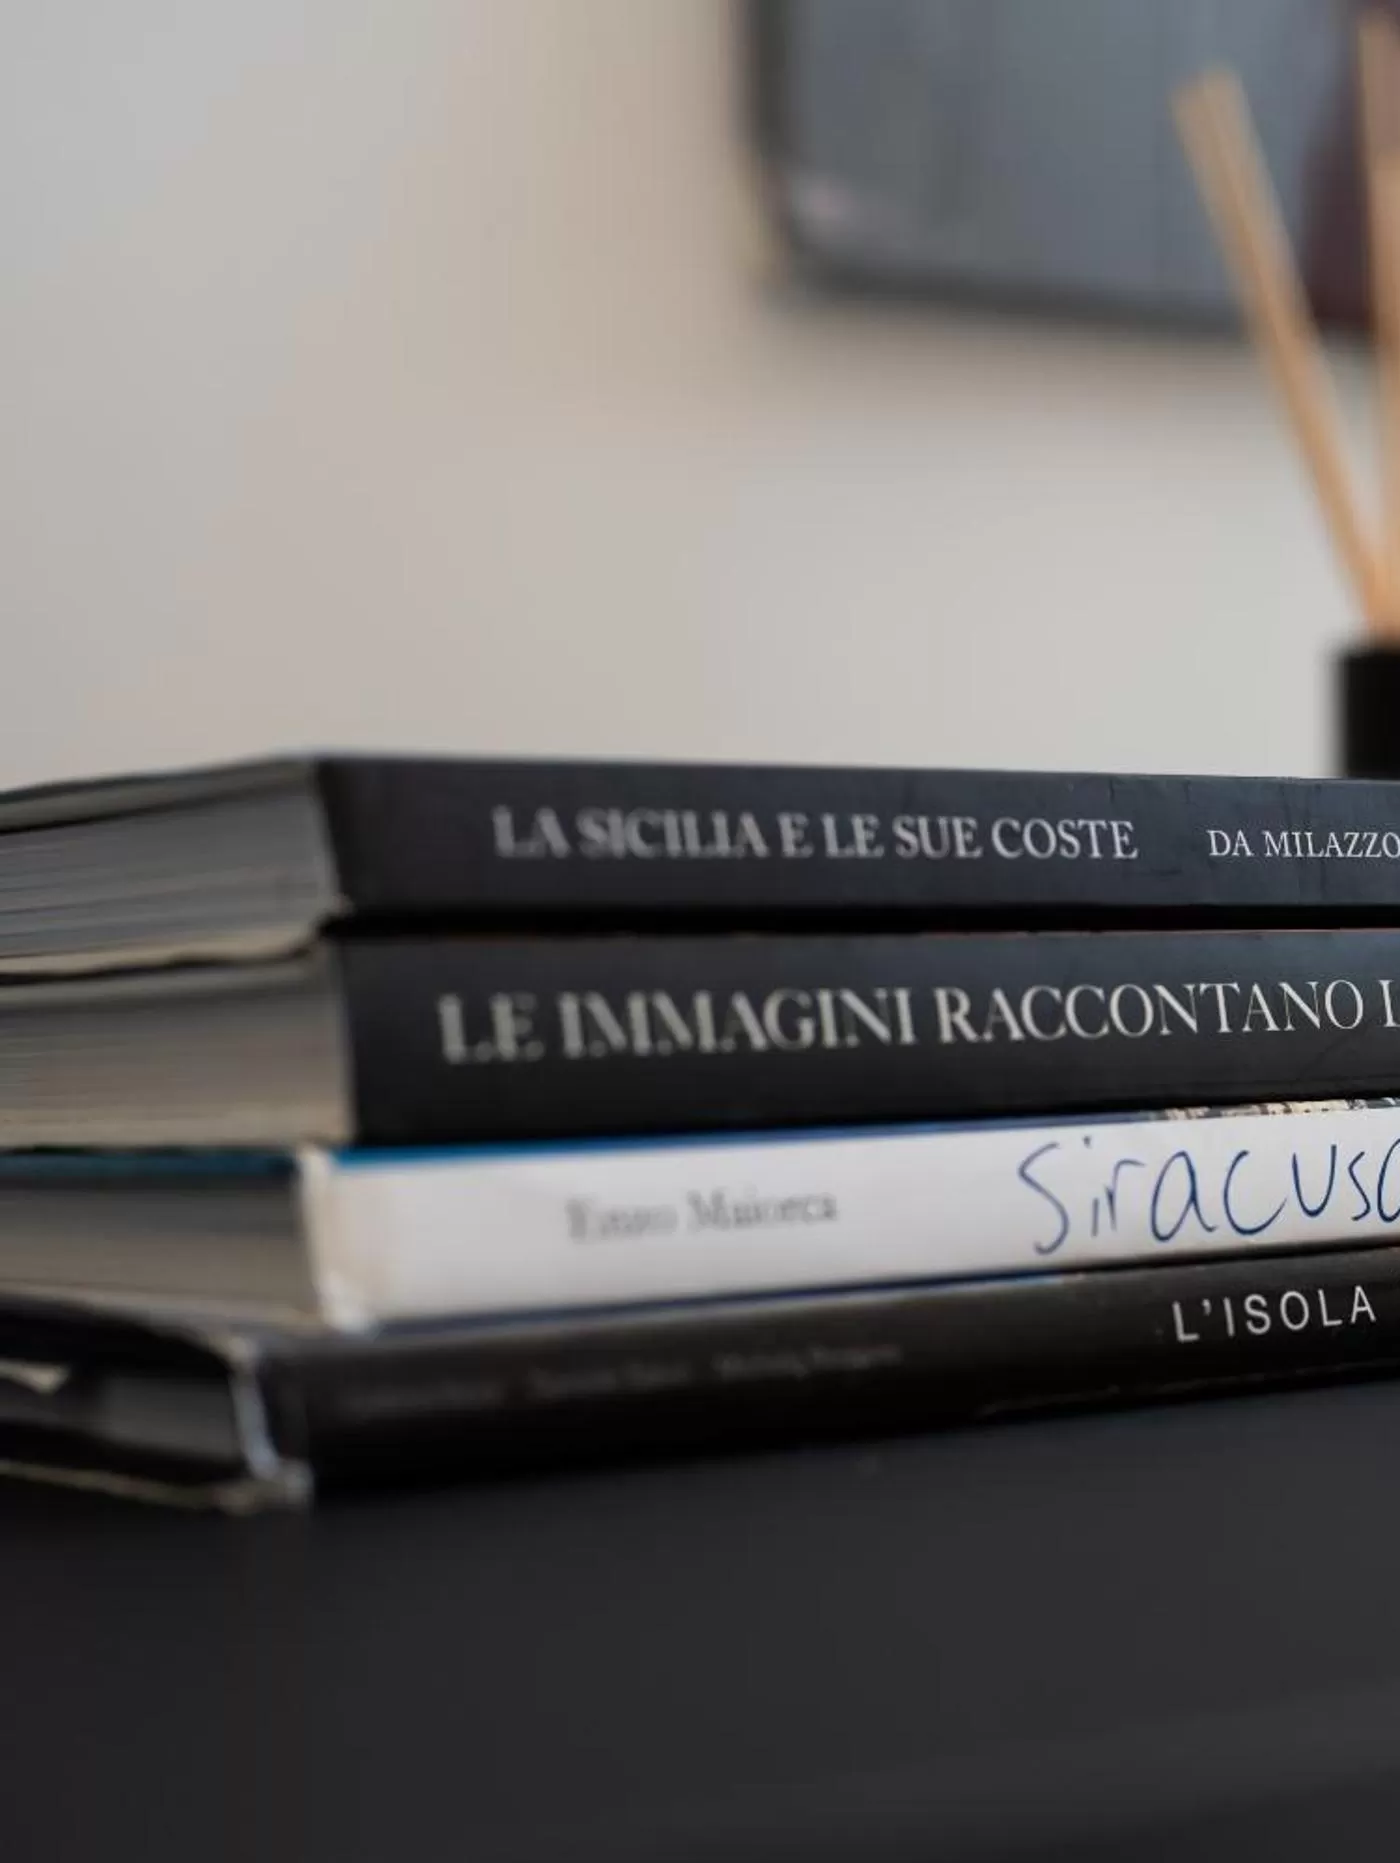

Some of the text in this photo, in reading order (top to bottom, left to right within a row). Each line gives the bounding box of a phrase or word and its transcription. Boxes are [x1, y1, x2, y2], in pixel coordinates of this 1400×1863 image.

[492, 803, 1138, 860] LA SICILIA E LE SUE COSTE
[1207, 829, 1254, 858] DA
[438, 992, 546, 1064] LE
[555, 987, 919, 1057] IMMAGINI
[932, 979, 1364, 1046] RACCONTANO
[1172, 1284, 1378, 1343] L'ISOLA
